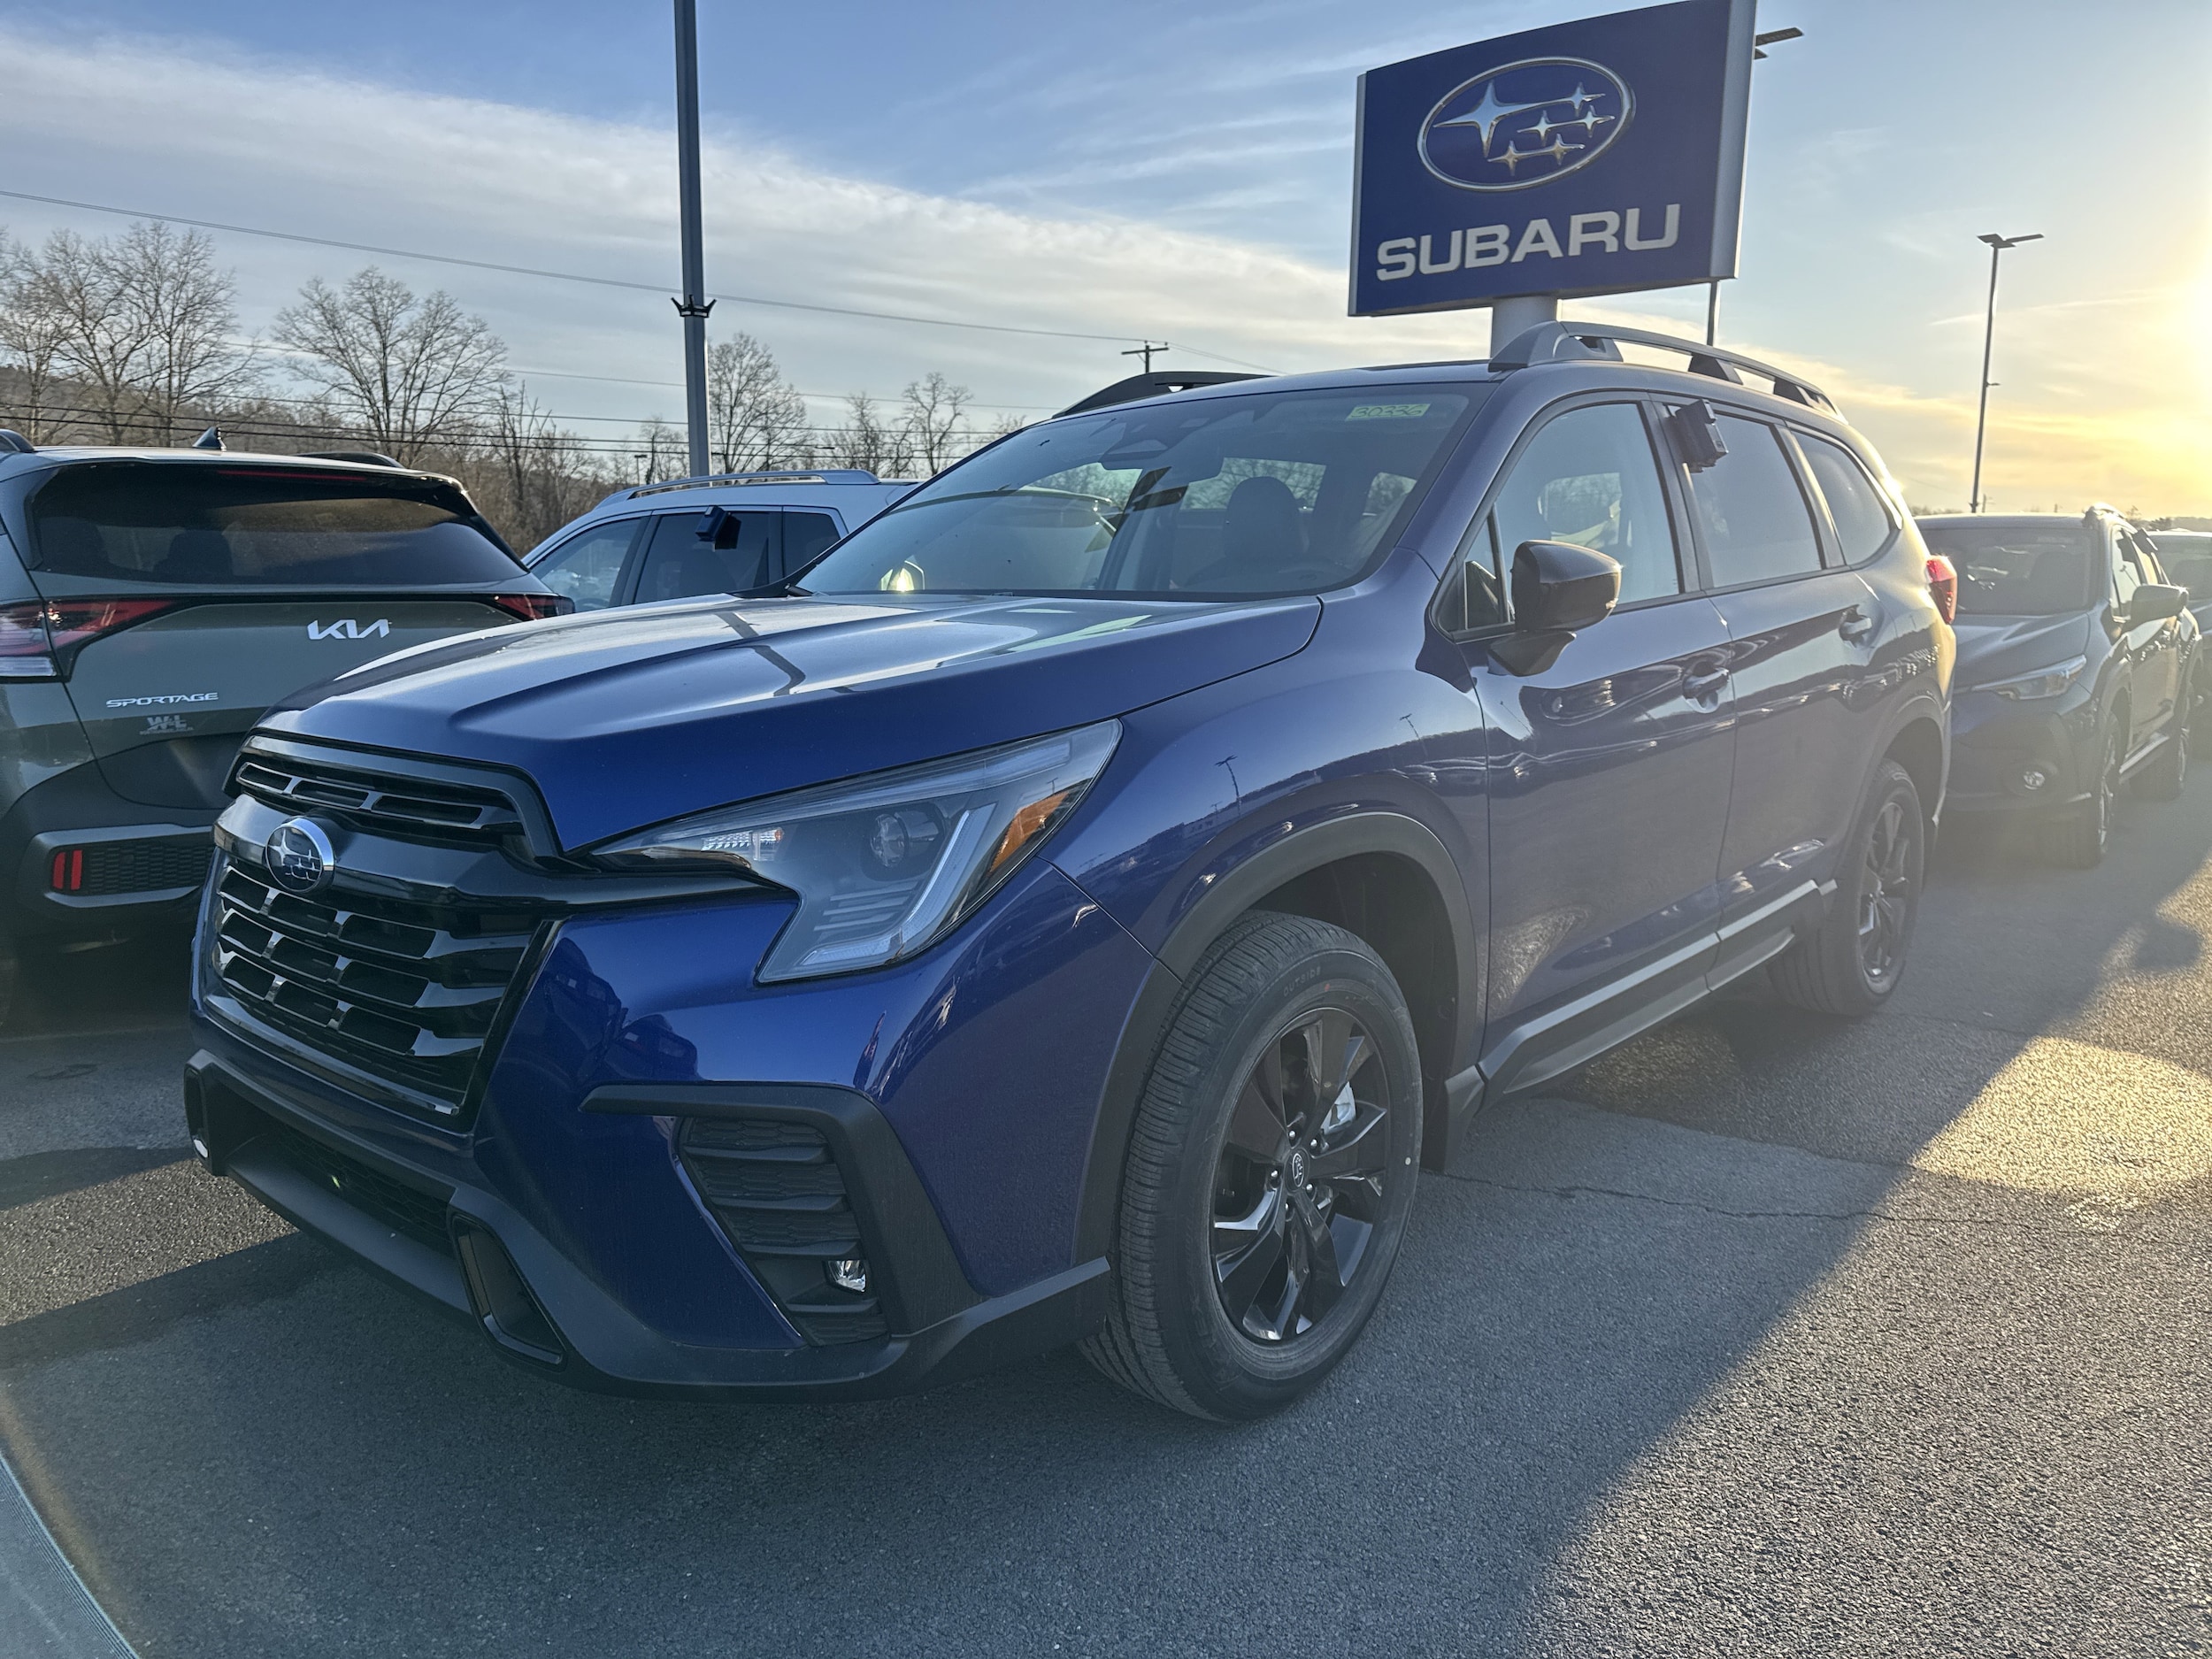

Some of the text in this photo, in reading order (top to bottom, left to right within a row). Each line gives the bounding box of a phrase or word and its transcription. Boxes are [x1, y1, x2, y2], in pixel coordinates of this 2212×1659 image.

[1376, 204, 1680, 281] SUBARU
[307, 618, 389, 640] KIA
[105, 692, 219, 708] SPORTAGE
